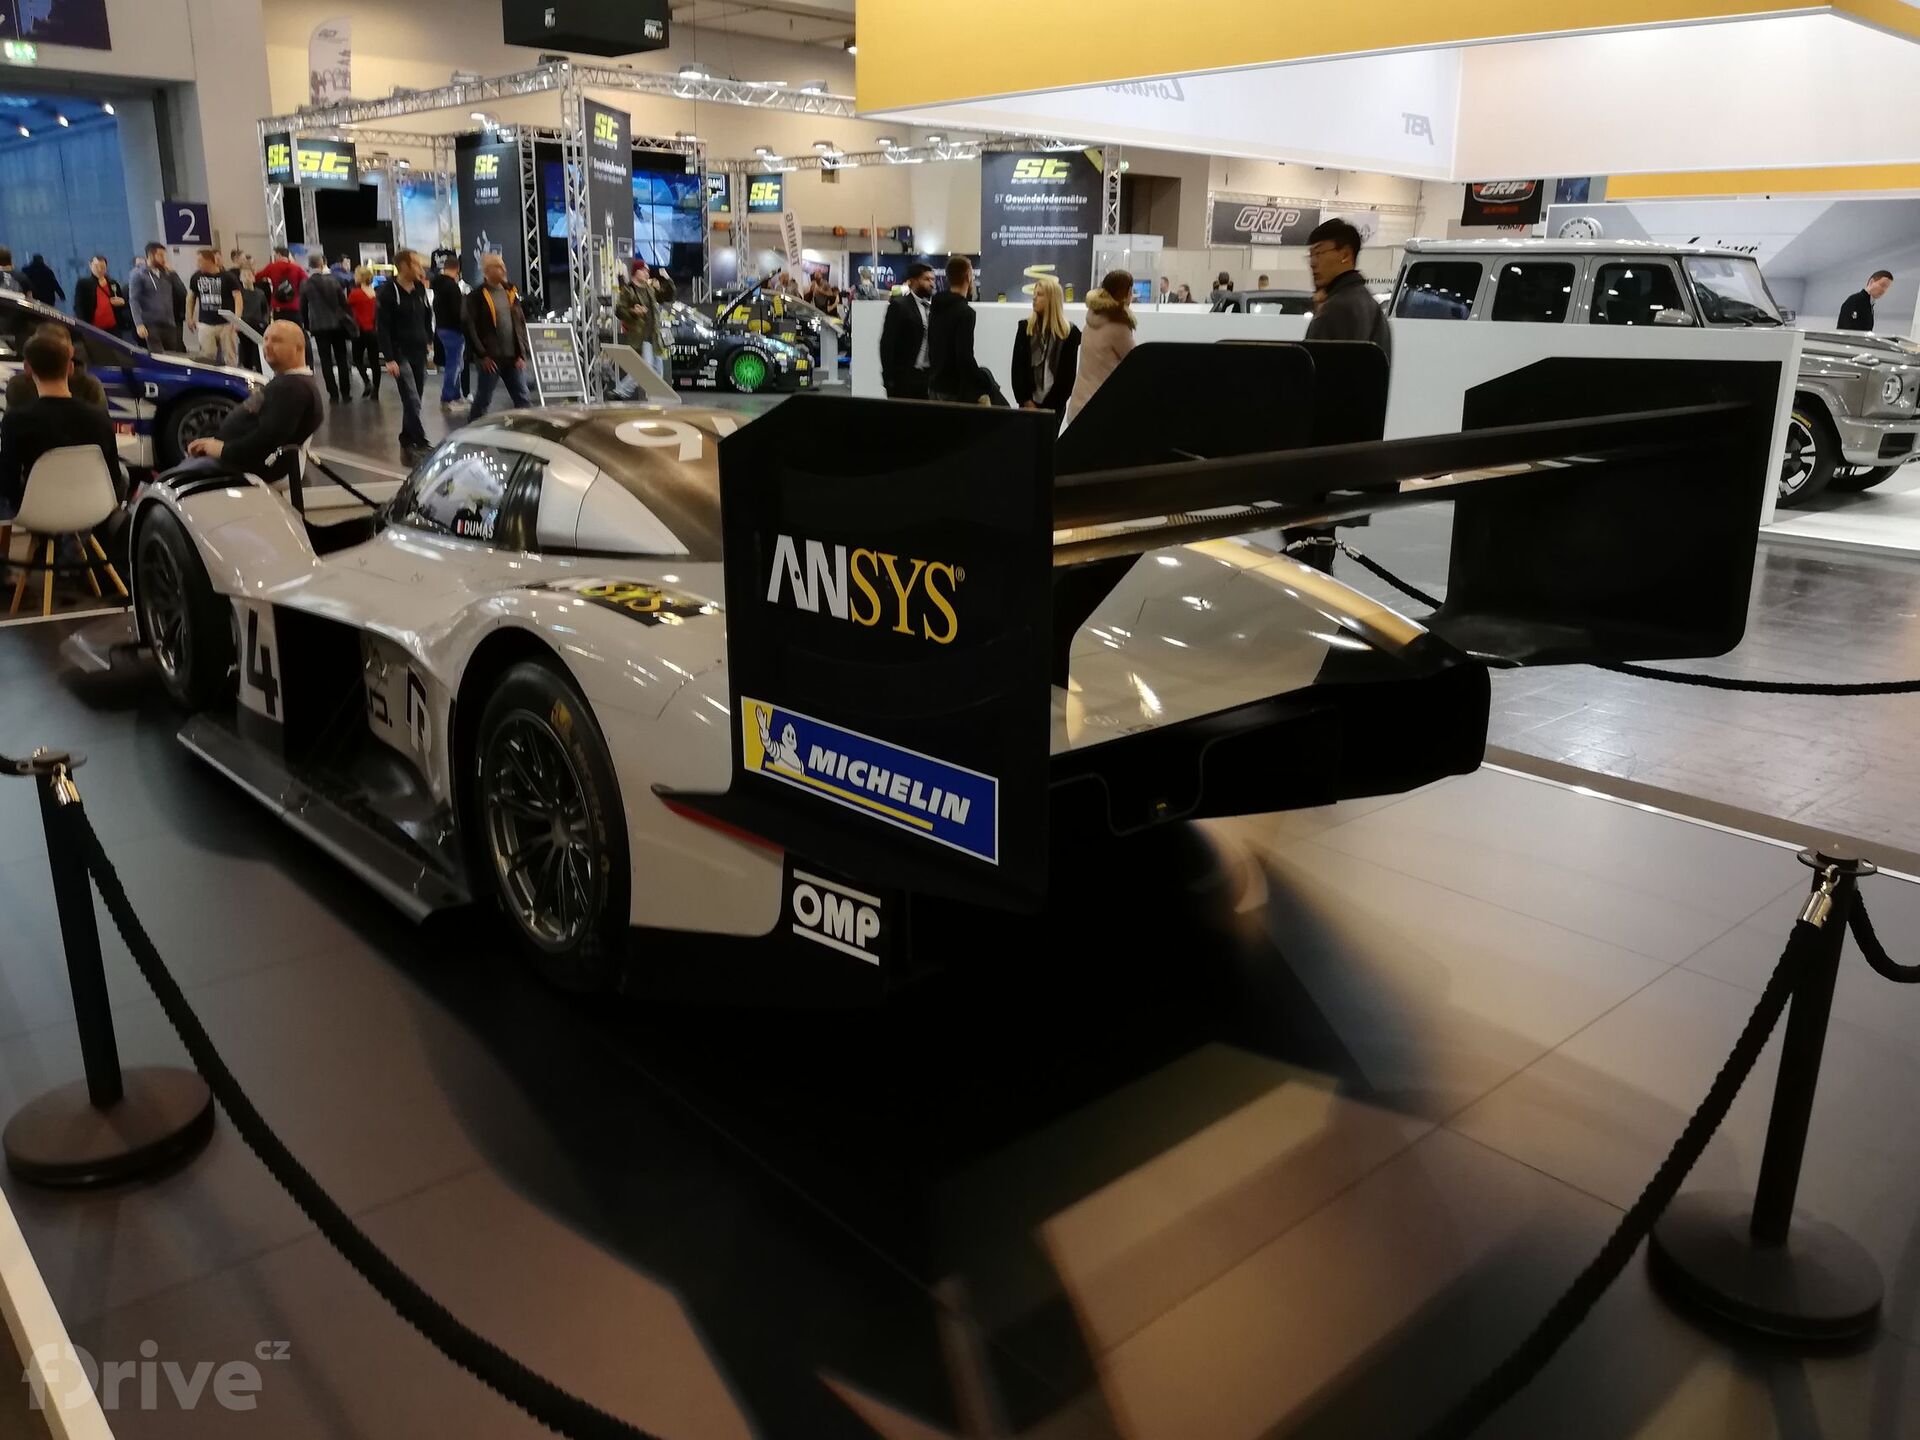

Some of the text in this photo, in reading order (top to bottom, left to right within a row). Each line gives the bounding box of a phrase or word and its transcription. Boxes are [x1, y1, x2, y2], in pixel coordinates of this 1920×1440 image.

[179, 208, 201, 242] 2
[1234, 206, 1300, 233] GRIP
[464, 519, 494, 540] DUMAS
[248, 608, 279, 718] 4
[808, 744, 971, 825] MICHELIN
[792, 883, 881, 948] OMP
